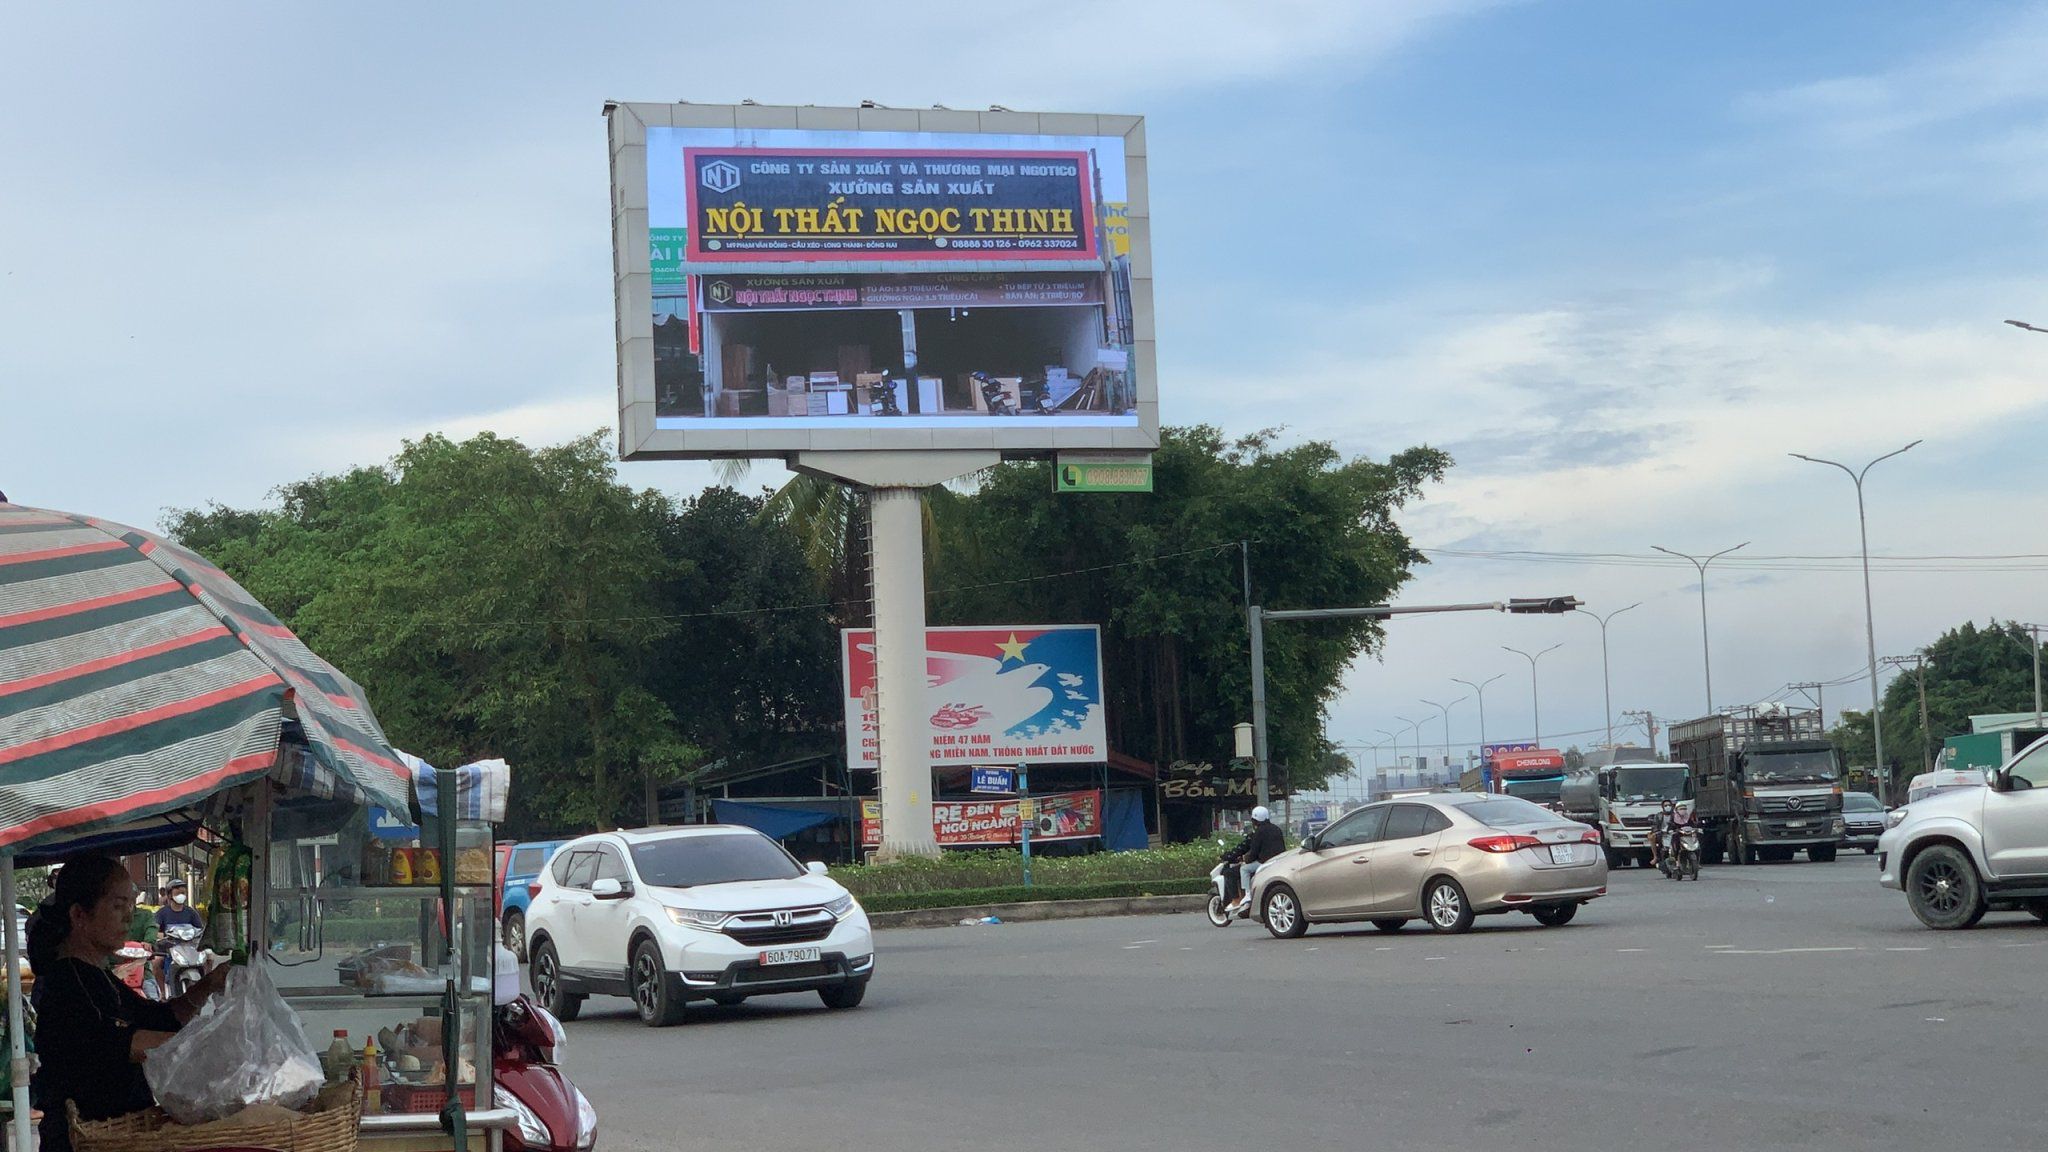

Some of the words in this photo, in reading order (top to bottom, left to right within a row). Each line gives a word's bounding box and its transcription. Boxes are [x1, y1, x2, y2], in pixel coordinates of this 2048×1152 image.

[750, 161, 790, 175] CÔNG
[798, 164, 814, 175] TY
[855, 160, 892, 176] XUẤT
[900, 162, 918, 175] VÀ
[924, 163, 981, 176] THƯƠNG
[987, 164, 1015, 177] MẠI
[1020, 165, 1077, 177] NGOTICO
[828, 178, 894, 195] XƯỞNG
[947, 179, 995, 195] XUẤT
[706, 201, 764, 239] NỘI
[773, 196, 863, 233] THẤT
[874, 207, 961, 240] NGỌC
[969, 208, 1074, 239] THỊNH
[982, 239, 994, 248] 30
[995, 239, 1011, 248] 126
[1018, 239, 1043, 248] 0962
[1044, 239, 1077, 248] 337024
[958, 735, 969, 745] 47
[1516, 758, 1551, 767] CHENGLONG
